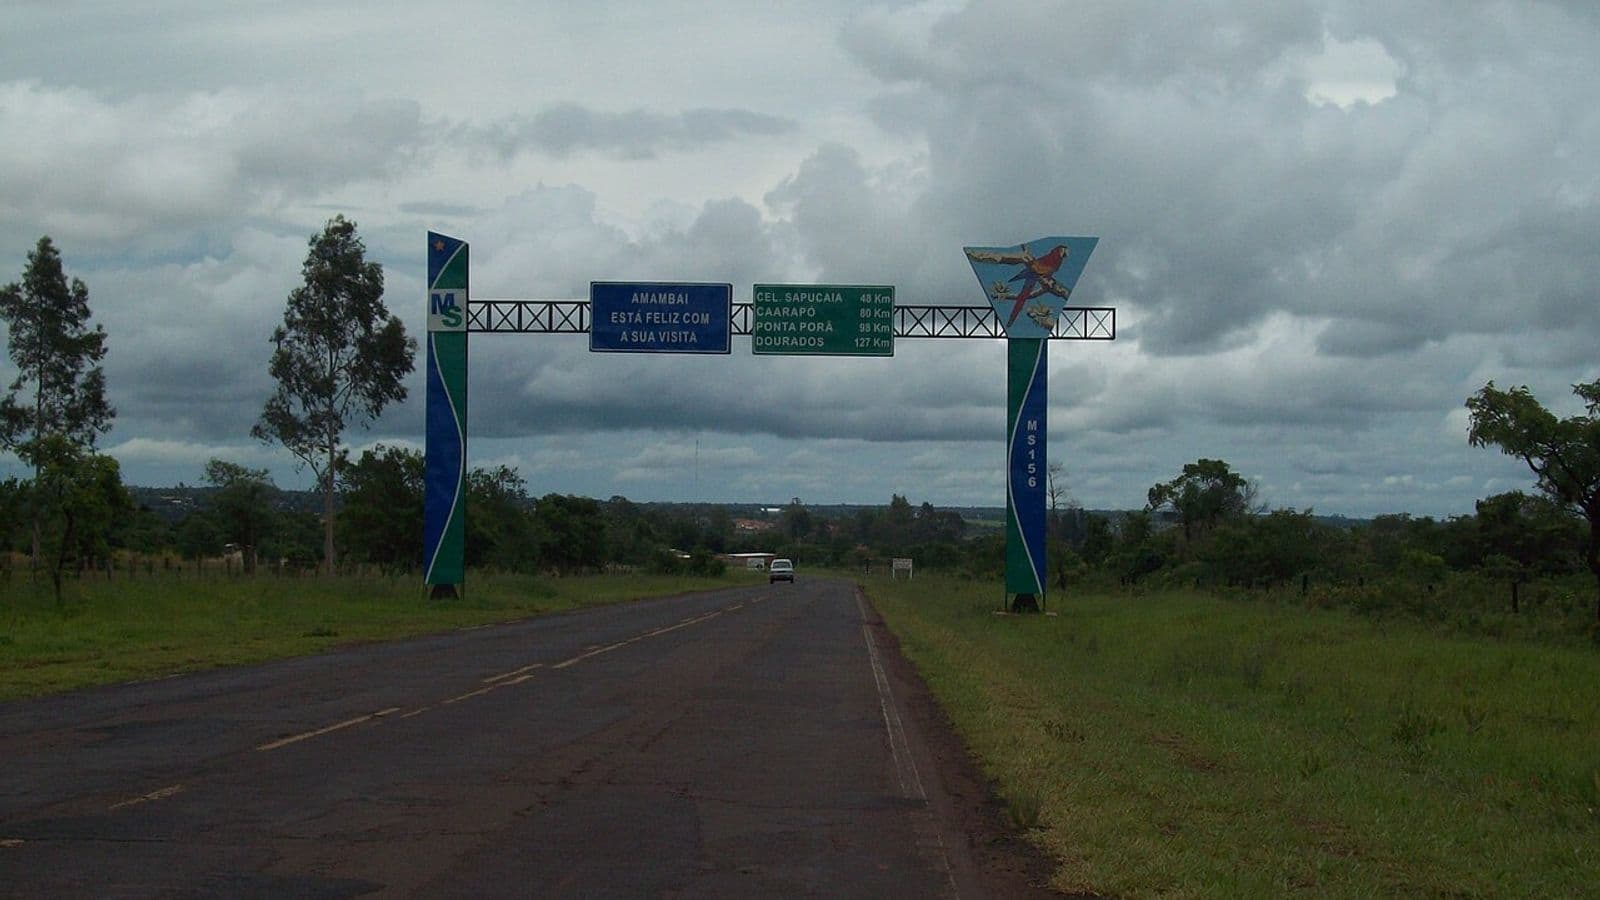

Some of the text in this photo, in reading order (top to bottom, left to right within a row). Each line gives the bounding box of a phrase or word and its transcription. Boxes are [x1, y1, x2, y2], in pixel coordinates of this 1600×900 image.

[631, 292, 688, 305] AMAMBAI
[756, 292, 781, 302] CEL.
[785, 292, 843, 303] SAPUCAIA
[874, 293, 890, 304] Km
[431, 293, 462, 327] MS
[756, 305, 816, 317] CAARAPÓ
[874, 308, 890, 318] Km
[611, 310, 710, 325] ESTÁ FELIZ COM
[756, 321, 796, 332] PONTA
[873, 323, 890, 333] Km
[620, 331, 698, 343] A SUA VISITA
[756, 336, 890, 348] DOURADOS 127 Km
